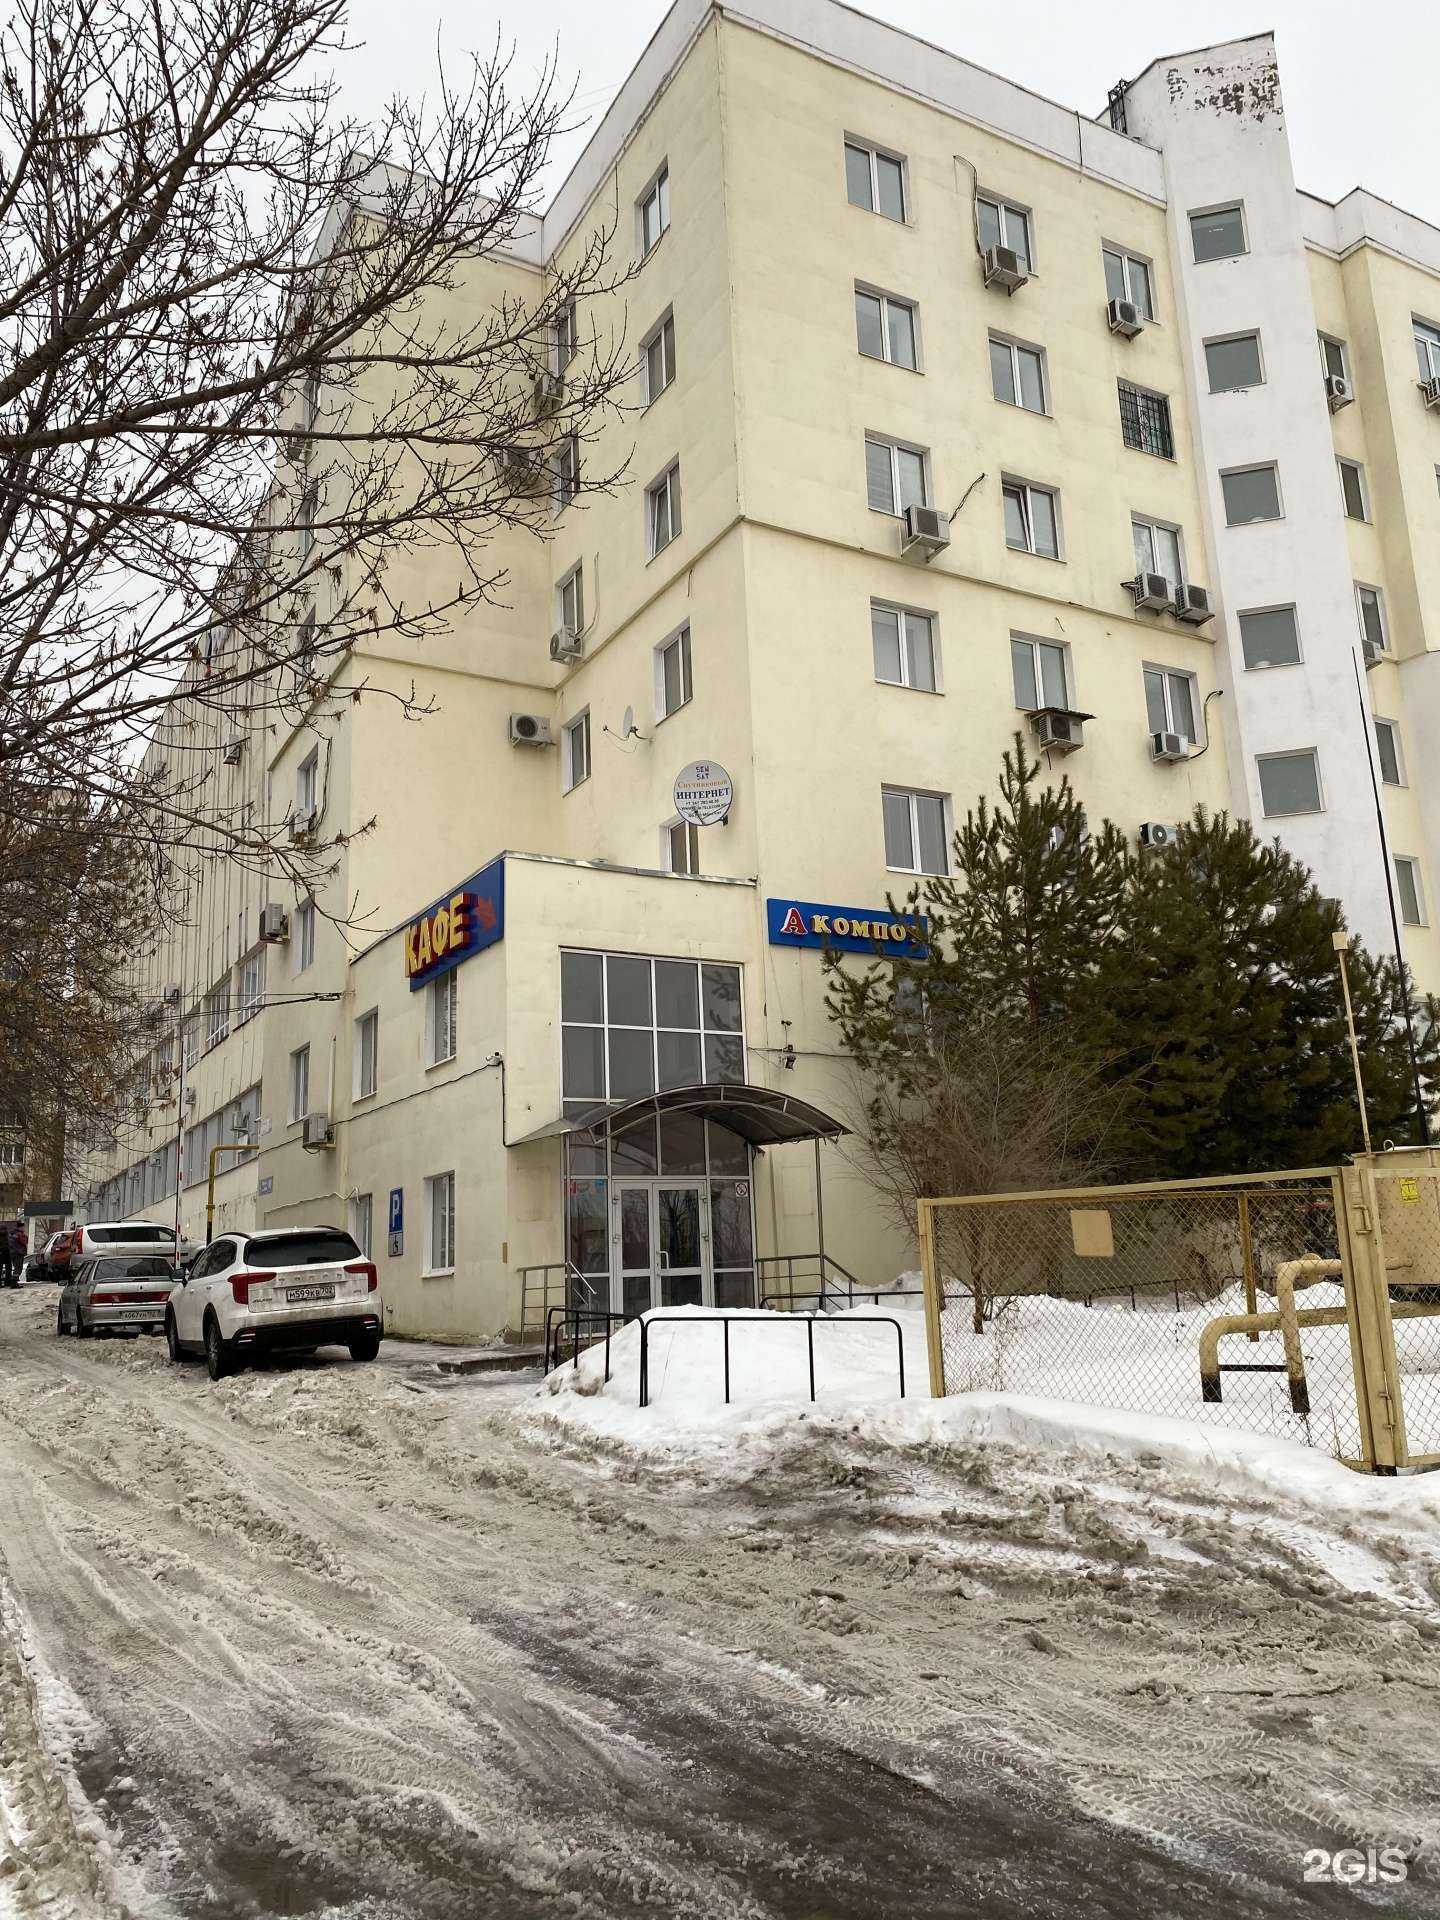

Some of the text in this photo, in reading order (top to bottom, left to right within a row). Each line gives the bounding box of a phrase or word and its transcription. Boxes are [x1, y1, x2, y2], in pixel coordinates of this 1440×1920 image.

[676, 788, 730, 799] ИНТЕРНЕТ
[404, 892, 464, 977] КАФЕ
[811, 914, 921, 943] КОМПО
[392, 1194, 400, 1228] P
